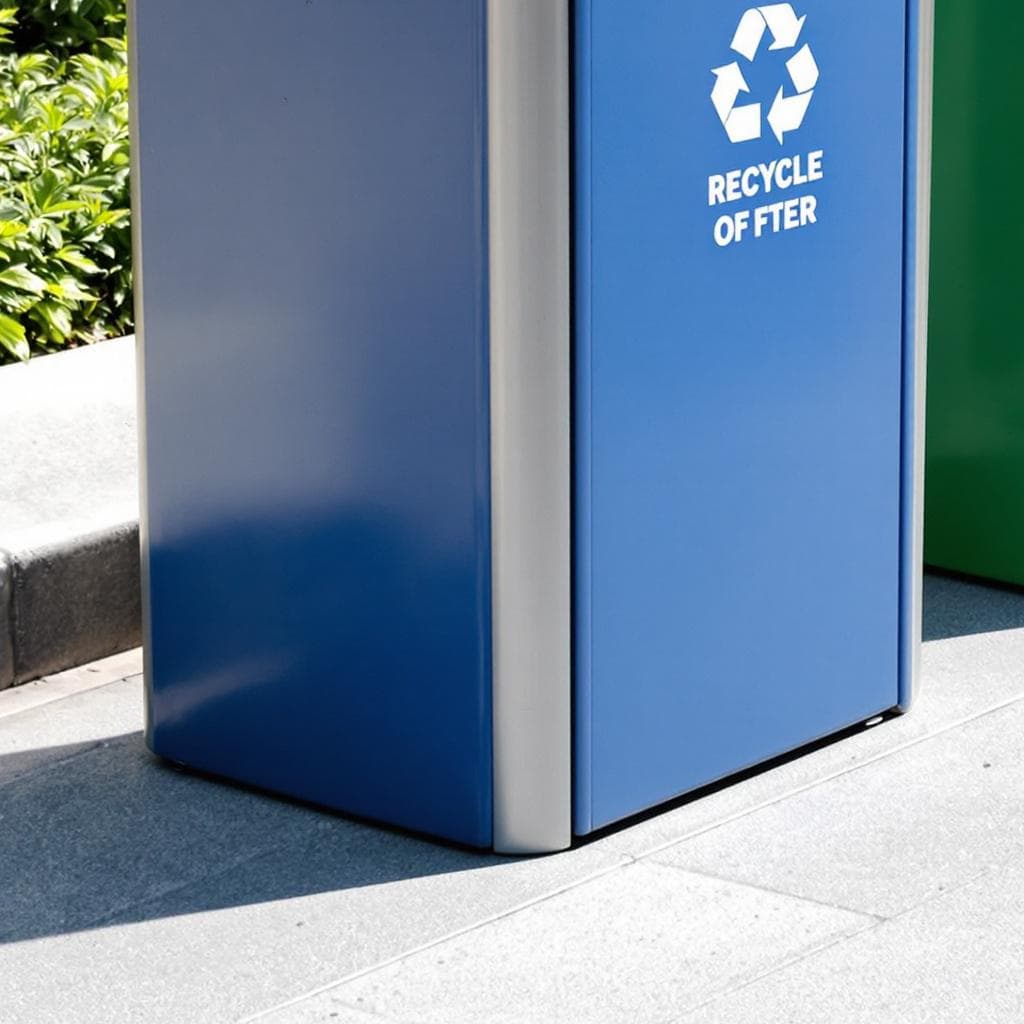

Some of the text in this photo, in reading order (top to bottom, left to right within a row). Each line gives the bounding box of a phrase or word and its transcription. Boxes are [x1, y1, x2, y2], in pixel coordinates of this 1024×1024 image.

[708, 150, 824, 206] RECYCLE
[713, 195, 818, 247] OF FTER
